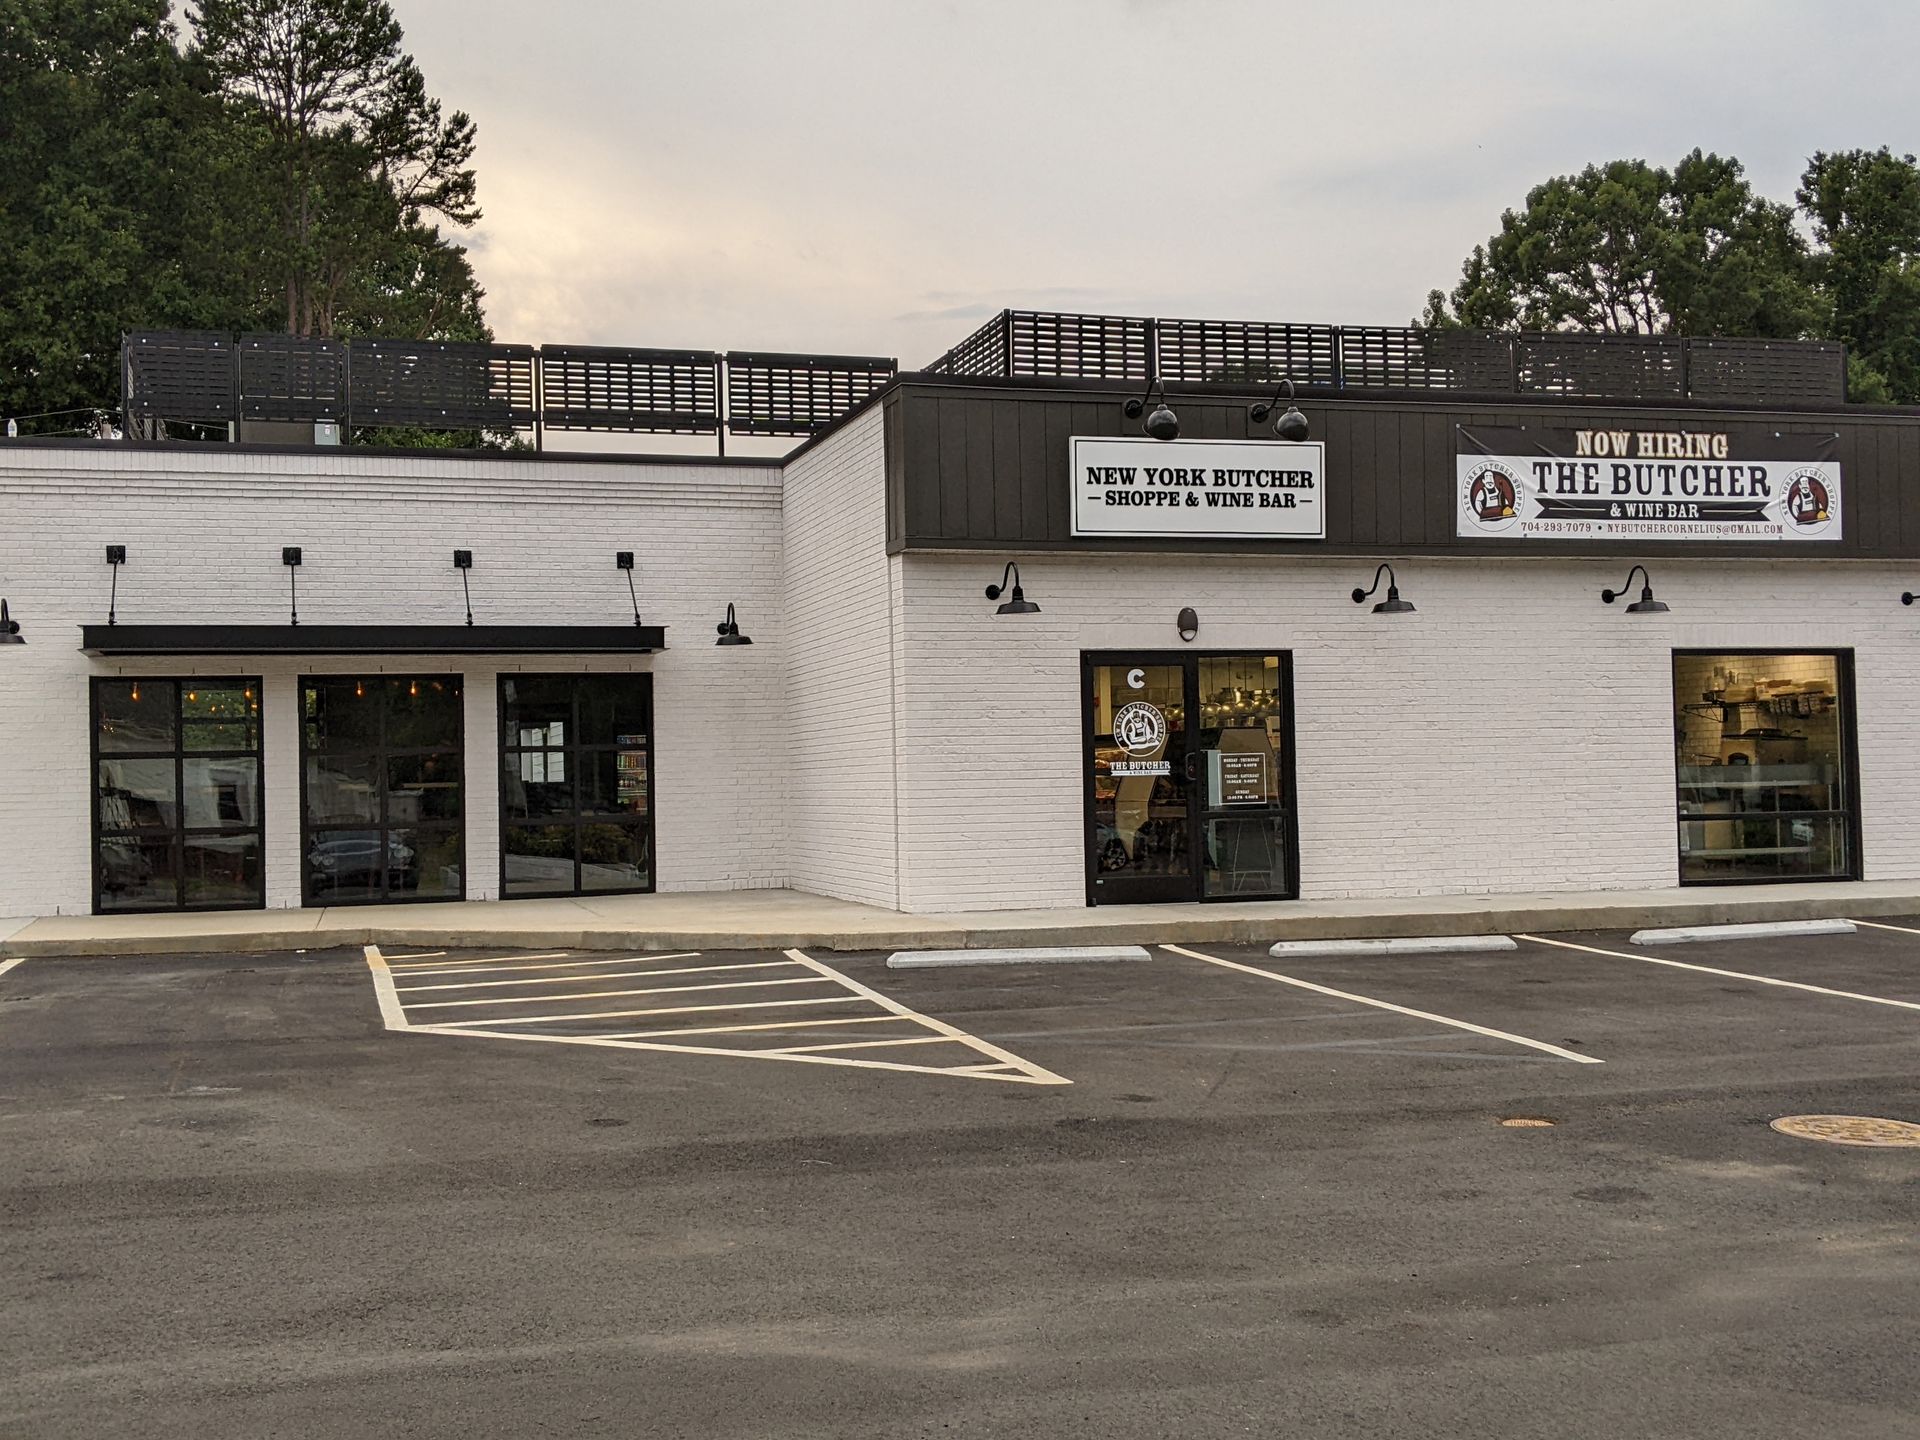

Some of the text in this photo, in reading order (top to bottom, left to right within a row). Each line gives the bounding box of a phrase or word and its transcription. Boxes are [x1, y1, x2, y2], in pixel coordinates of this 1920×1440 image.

[1575, 431, 1729, 459] NOW HIRING
[1086, 466, 1314, 488] NEW YORK BUTCHER
[1532, 462, 1770, 497] THE BUTCHER
[1105, 490, 1296, 508] SHOPPE & WINE BAR
[1610, 503, 1699, 518] & WINE BAR
[1520, 522, 1783, 535] 704-293-7079 NYBUTCHERCORNELIUS@GMAIL.COM
[1127, 668, 1145, 689] C
[1110, 761, 1171, 770] THE BUTCHER
